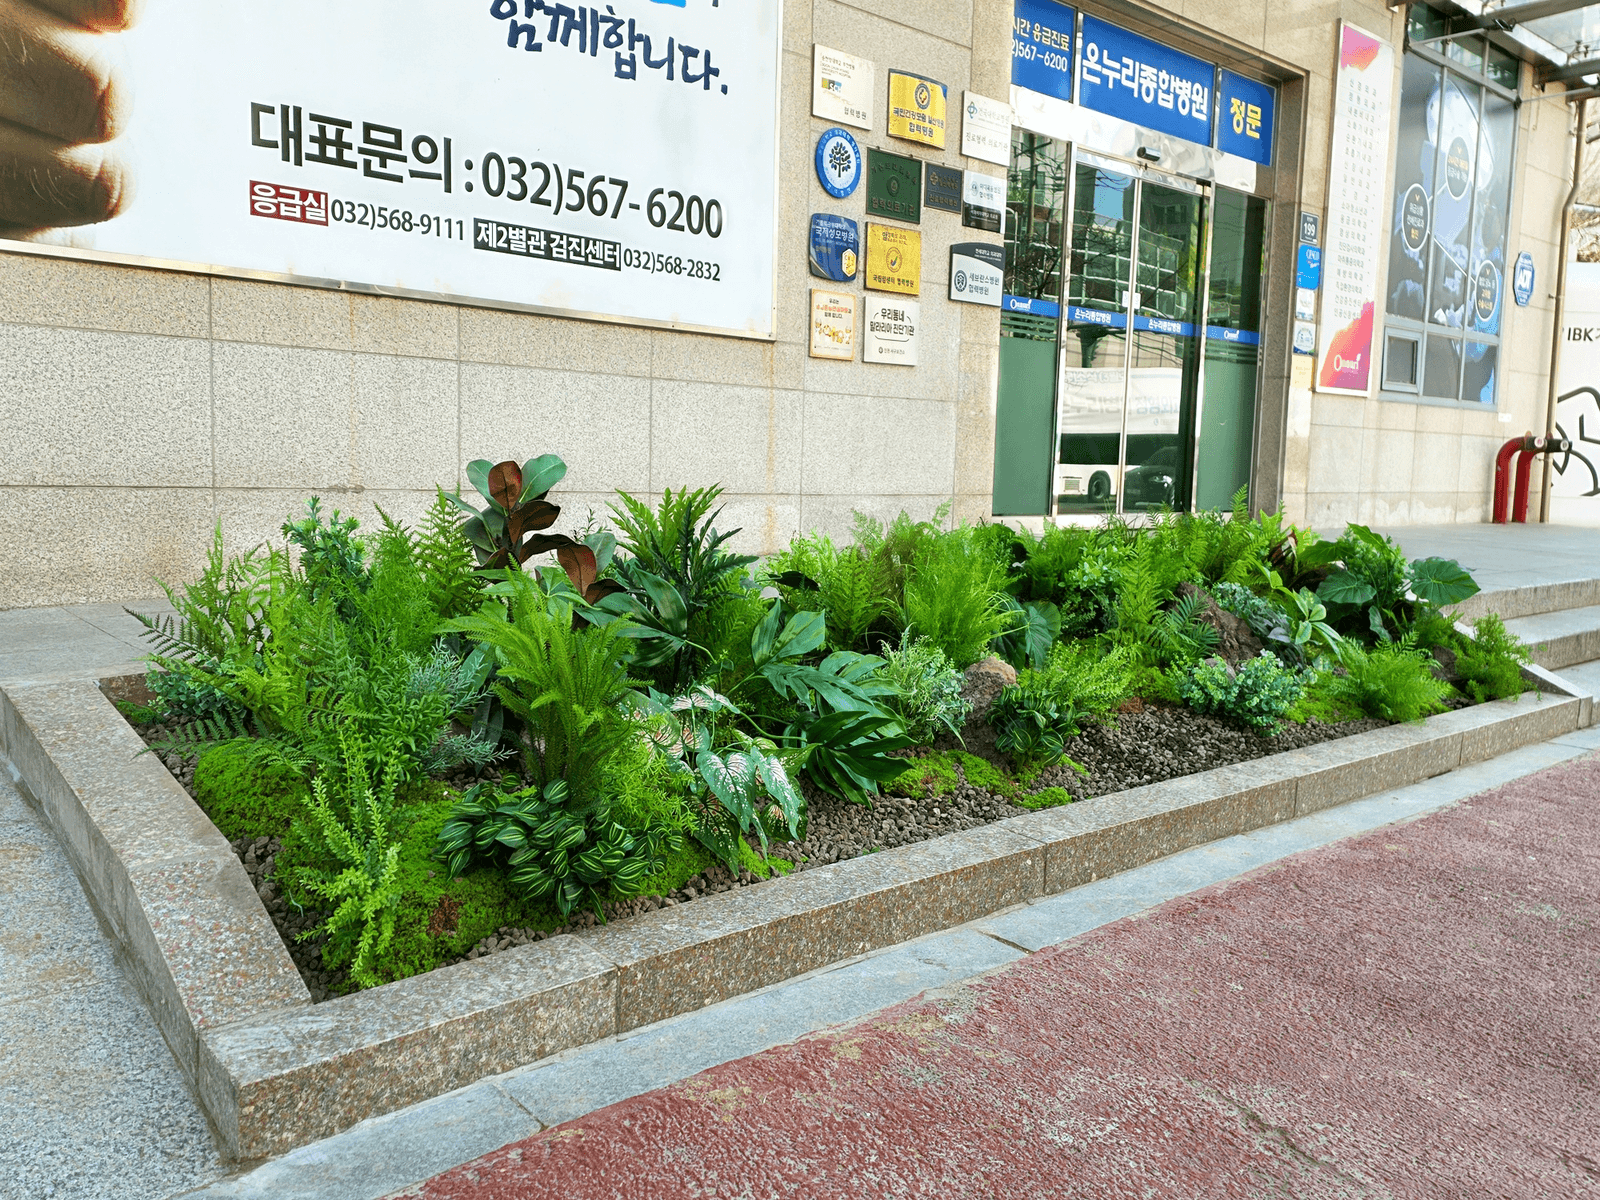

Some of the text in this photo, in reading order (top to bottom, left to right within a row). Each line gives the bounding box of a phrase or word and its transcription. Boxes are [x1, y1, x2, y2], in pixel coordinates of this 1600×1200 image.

[1033, 22, 1070, 52] 응급진료
[1082, 42, 1208, 121] 온누리종합병원
[1230, 97, 1261, 139] 정문
[909, 122, 934, 138] 협력병원
[251, 101, 452, 193] 대표문의
[481, 151, 723, 239] 032)567-6200
[252, 184, 721, 282] 응급실 032)568-9111 제2별관 검진센터 032)568-2832
[815, 226, 854, 243] 국제성모병원
[1304, 220, 1316, 237] 199
[969, 272, 1000, 286] 세브란스병원
[969, 284, 989, 296] 협력병원
[881, 307, 905, 322] 우리동네
[1075, 307, 1112, 325] 온누리종합병원
[870, 320, 915, 336] 말라리아 진단기관
[1148, 318, 1182, 334] 온누리종합병원
